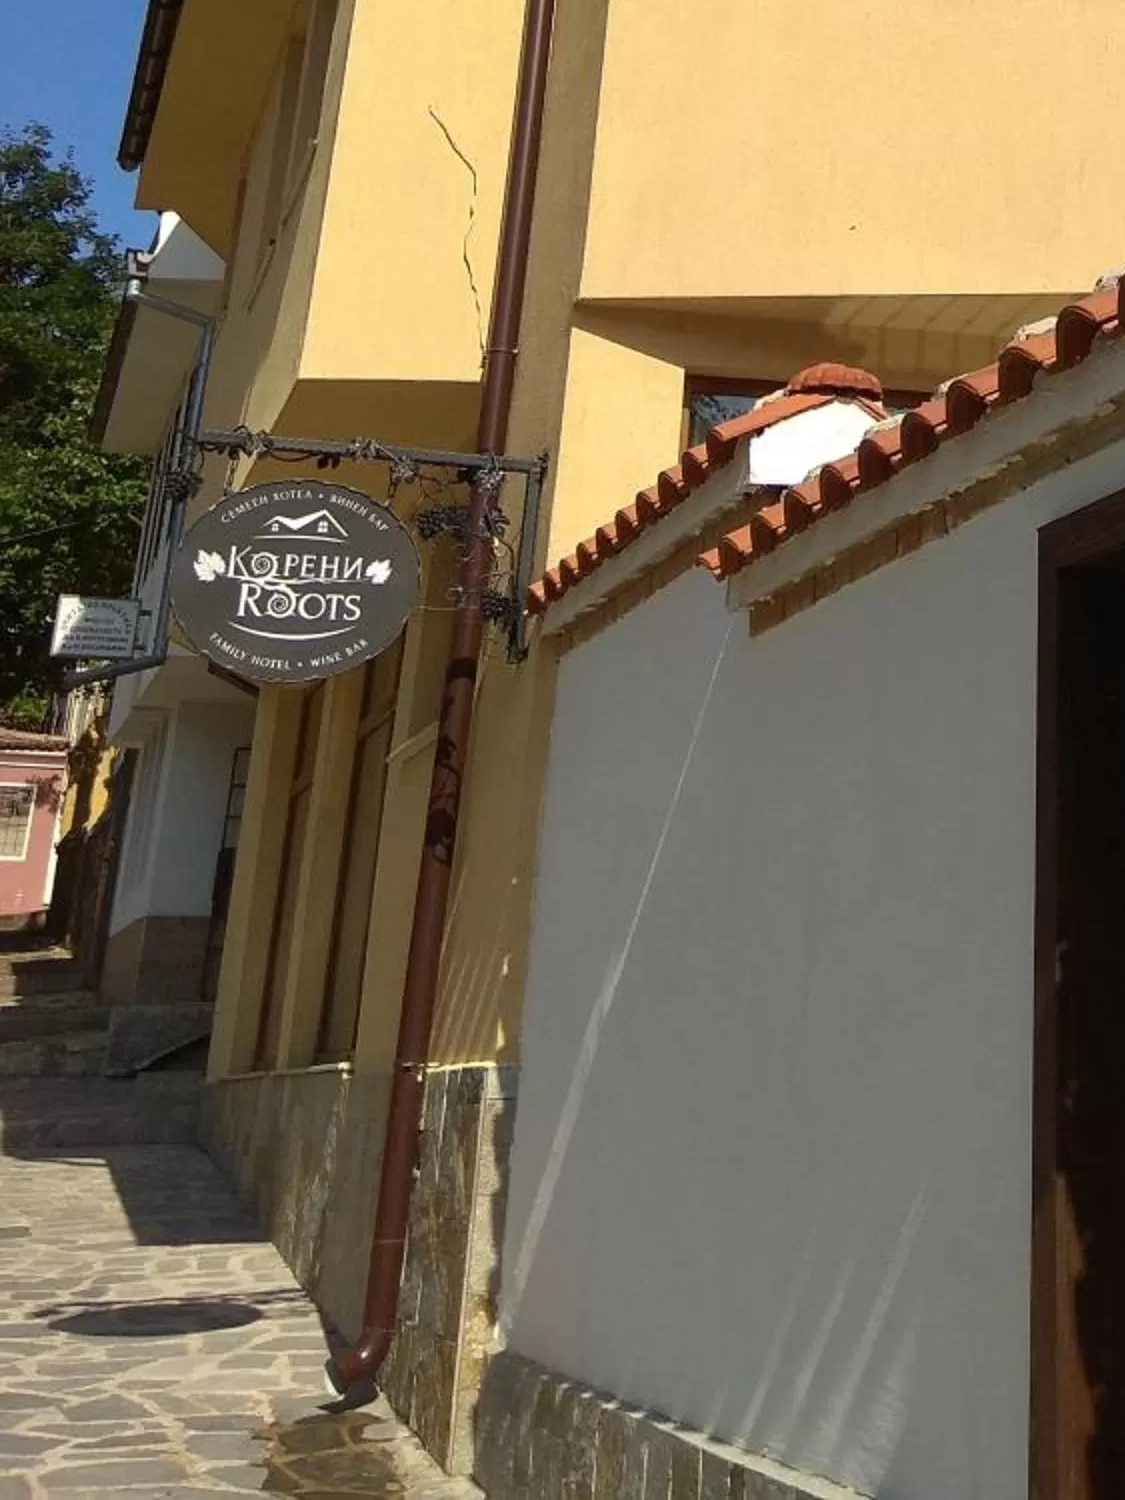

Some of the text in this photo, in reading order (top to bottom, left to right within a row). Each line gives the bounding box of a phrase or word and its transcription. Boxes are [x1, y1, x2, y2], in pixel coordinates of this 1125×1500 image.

[273, 489, 313, 501] ХОТЕЛ
[237, 583, 362, 621] ROOTS
[208, 632, 369, 670] FAMILY HOTEL WINE BAR
